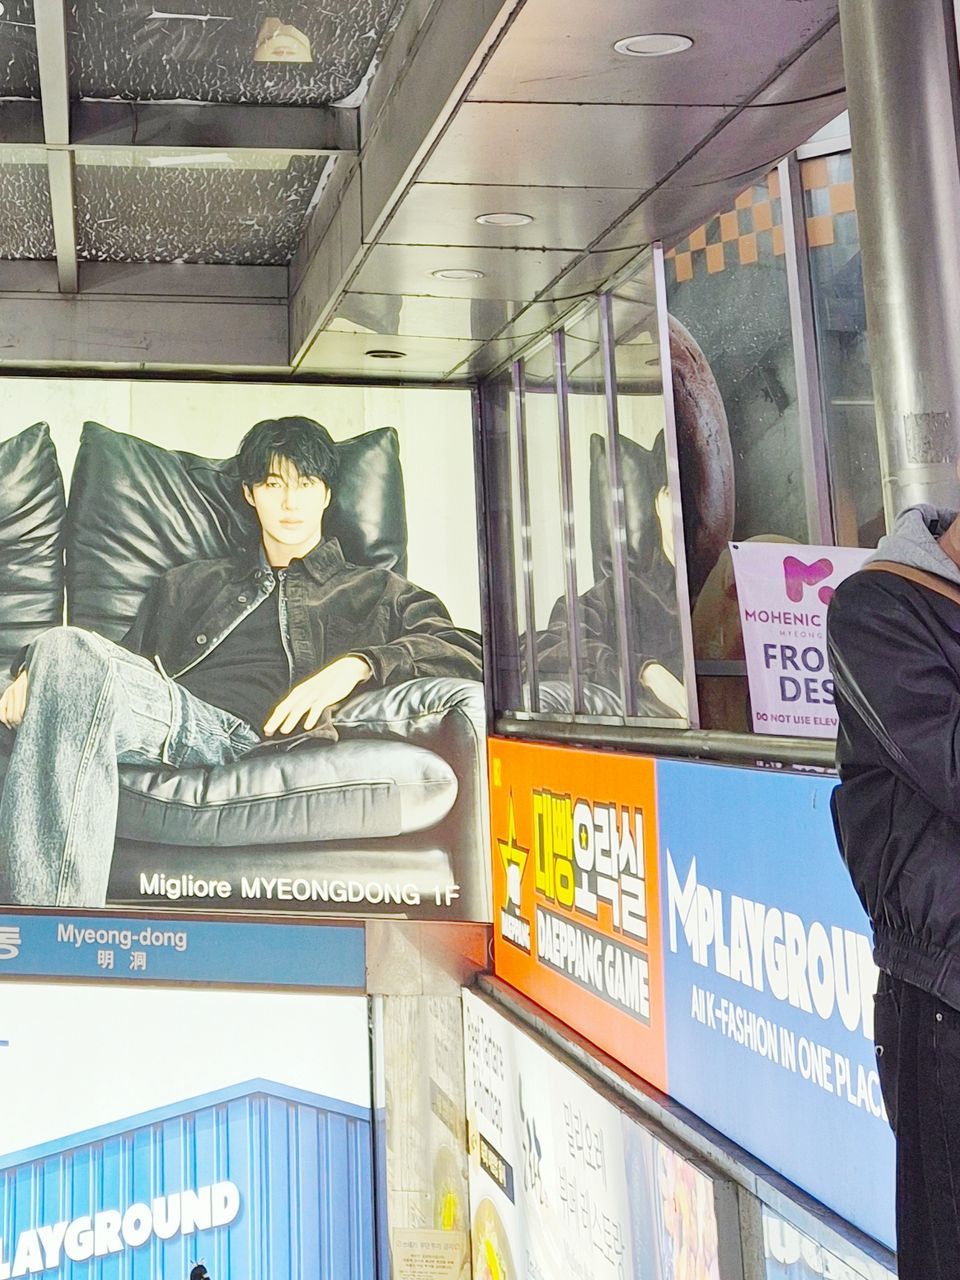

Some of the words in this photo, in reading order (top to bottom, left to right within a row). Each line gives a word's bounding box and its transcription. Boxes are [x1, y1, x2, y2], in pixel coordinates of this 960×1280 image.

[744, 609, 822, 627] MOHENIC
[763, 643, 825, 673] FRO
[139, 872, 232, 900] Migliore
[240, 876, 420, 906] MYEONGDONG
[432, 883, 461, 907] 1F
[57, 923, 188, 951] Myeong-dong
[537, 908, 603, 992] DAEPPANG
[604, 943, 651, 1020] GAME
[705, 989, 779, 1064] K-FASHION
[778, 1026, 797, 1073] IN
[797, 1036, 834, 1094] ONE
[833, 1052, 890, 1123] PLAC
